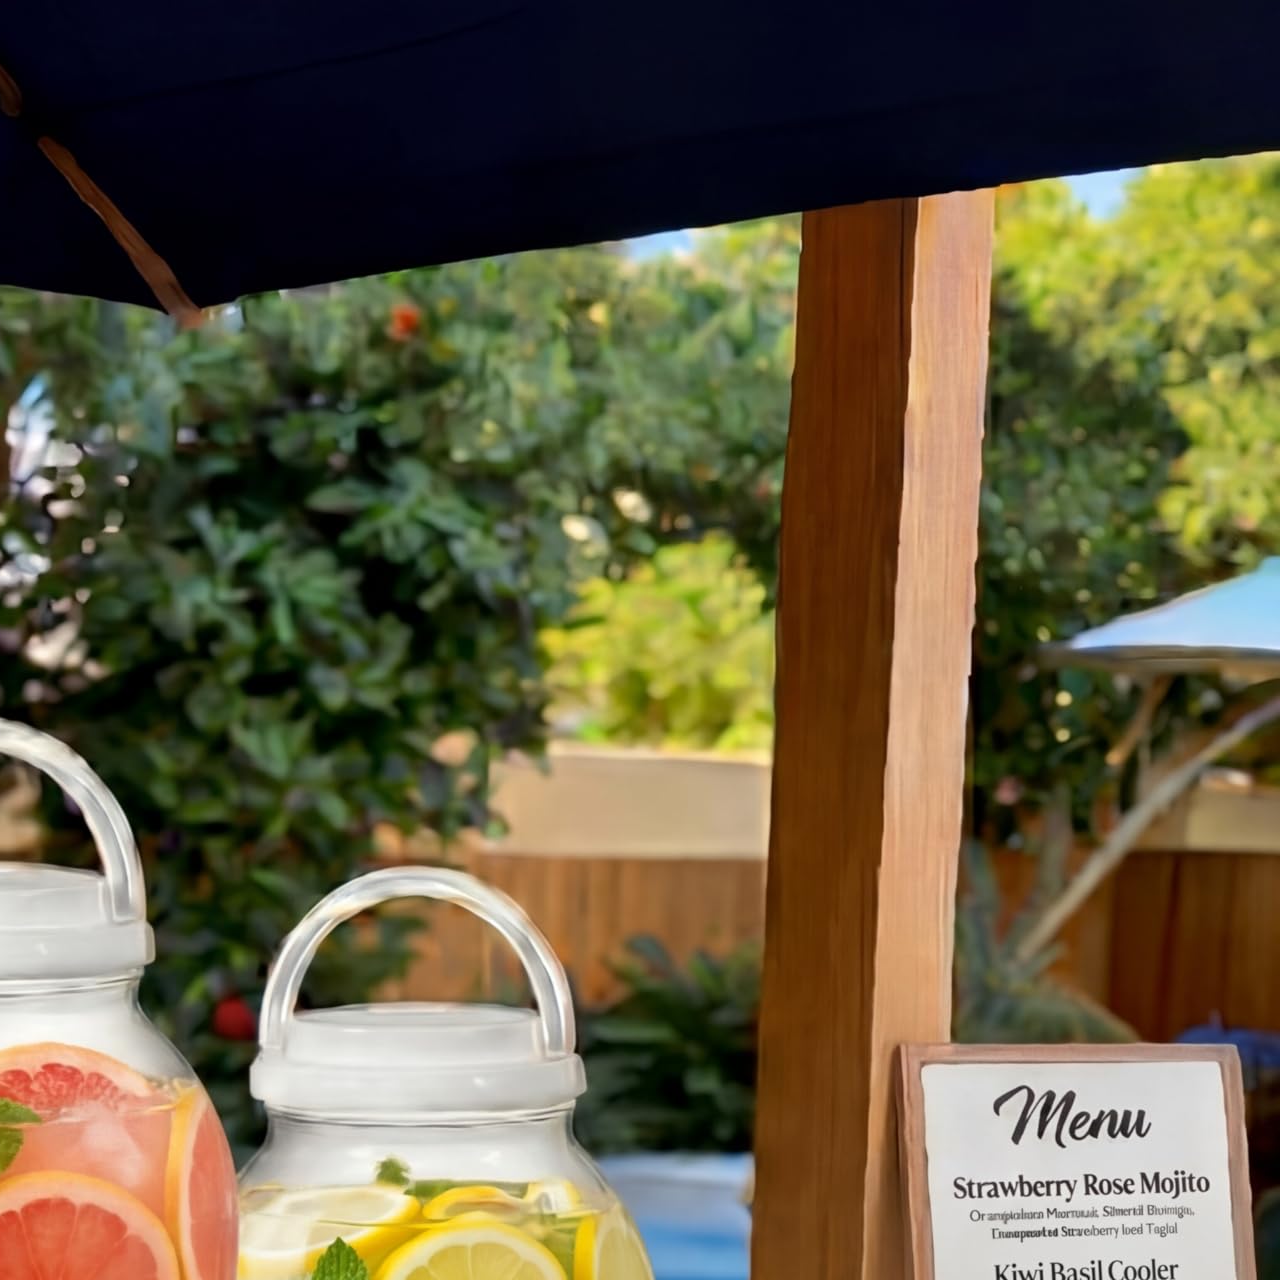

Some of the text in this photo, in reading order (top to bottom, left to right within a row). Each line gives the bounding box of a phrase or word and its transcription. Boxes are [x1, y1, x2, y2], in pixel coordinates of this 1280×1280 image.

[993, 1085, 1152, 1149] Menu
[953, 1170, 1210, 1203] Strawberry Rose Mojito
